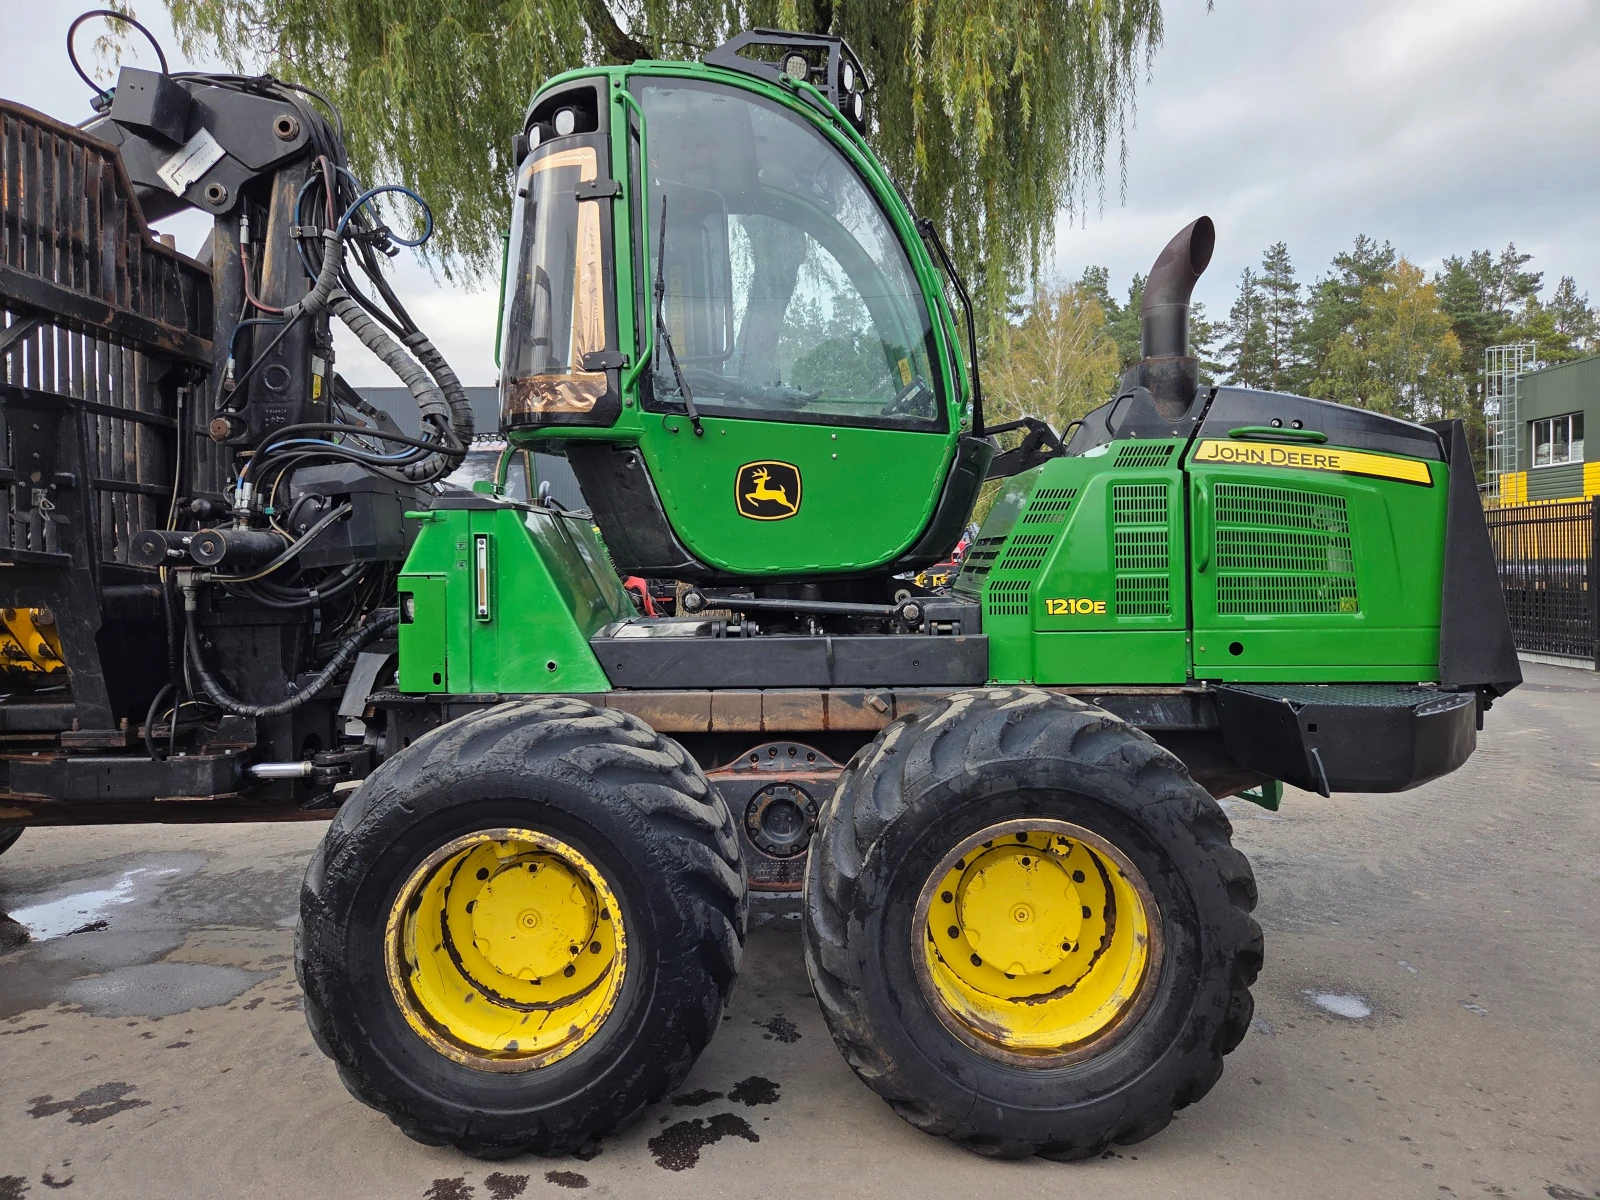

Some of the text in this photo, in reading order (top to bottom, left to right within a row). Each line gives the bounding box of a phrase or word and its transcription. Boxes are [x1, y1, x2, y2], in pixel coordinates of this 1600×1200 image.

[1208, 444, 1340, 468] JOHN DEERE
[1045, 598, 1107, 615] 1210E
